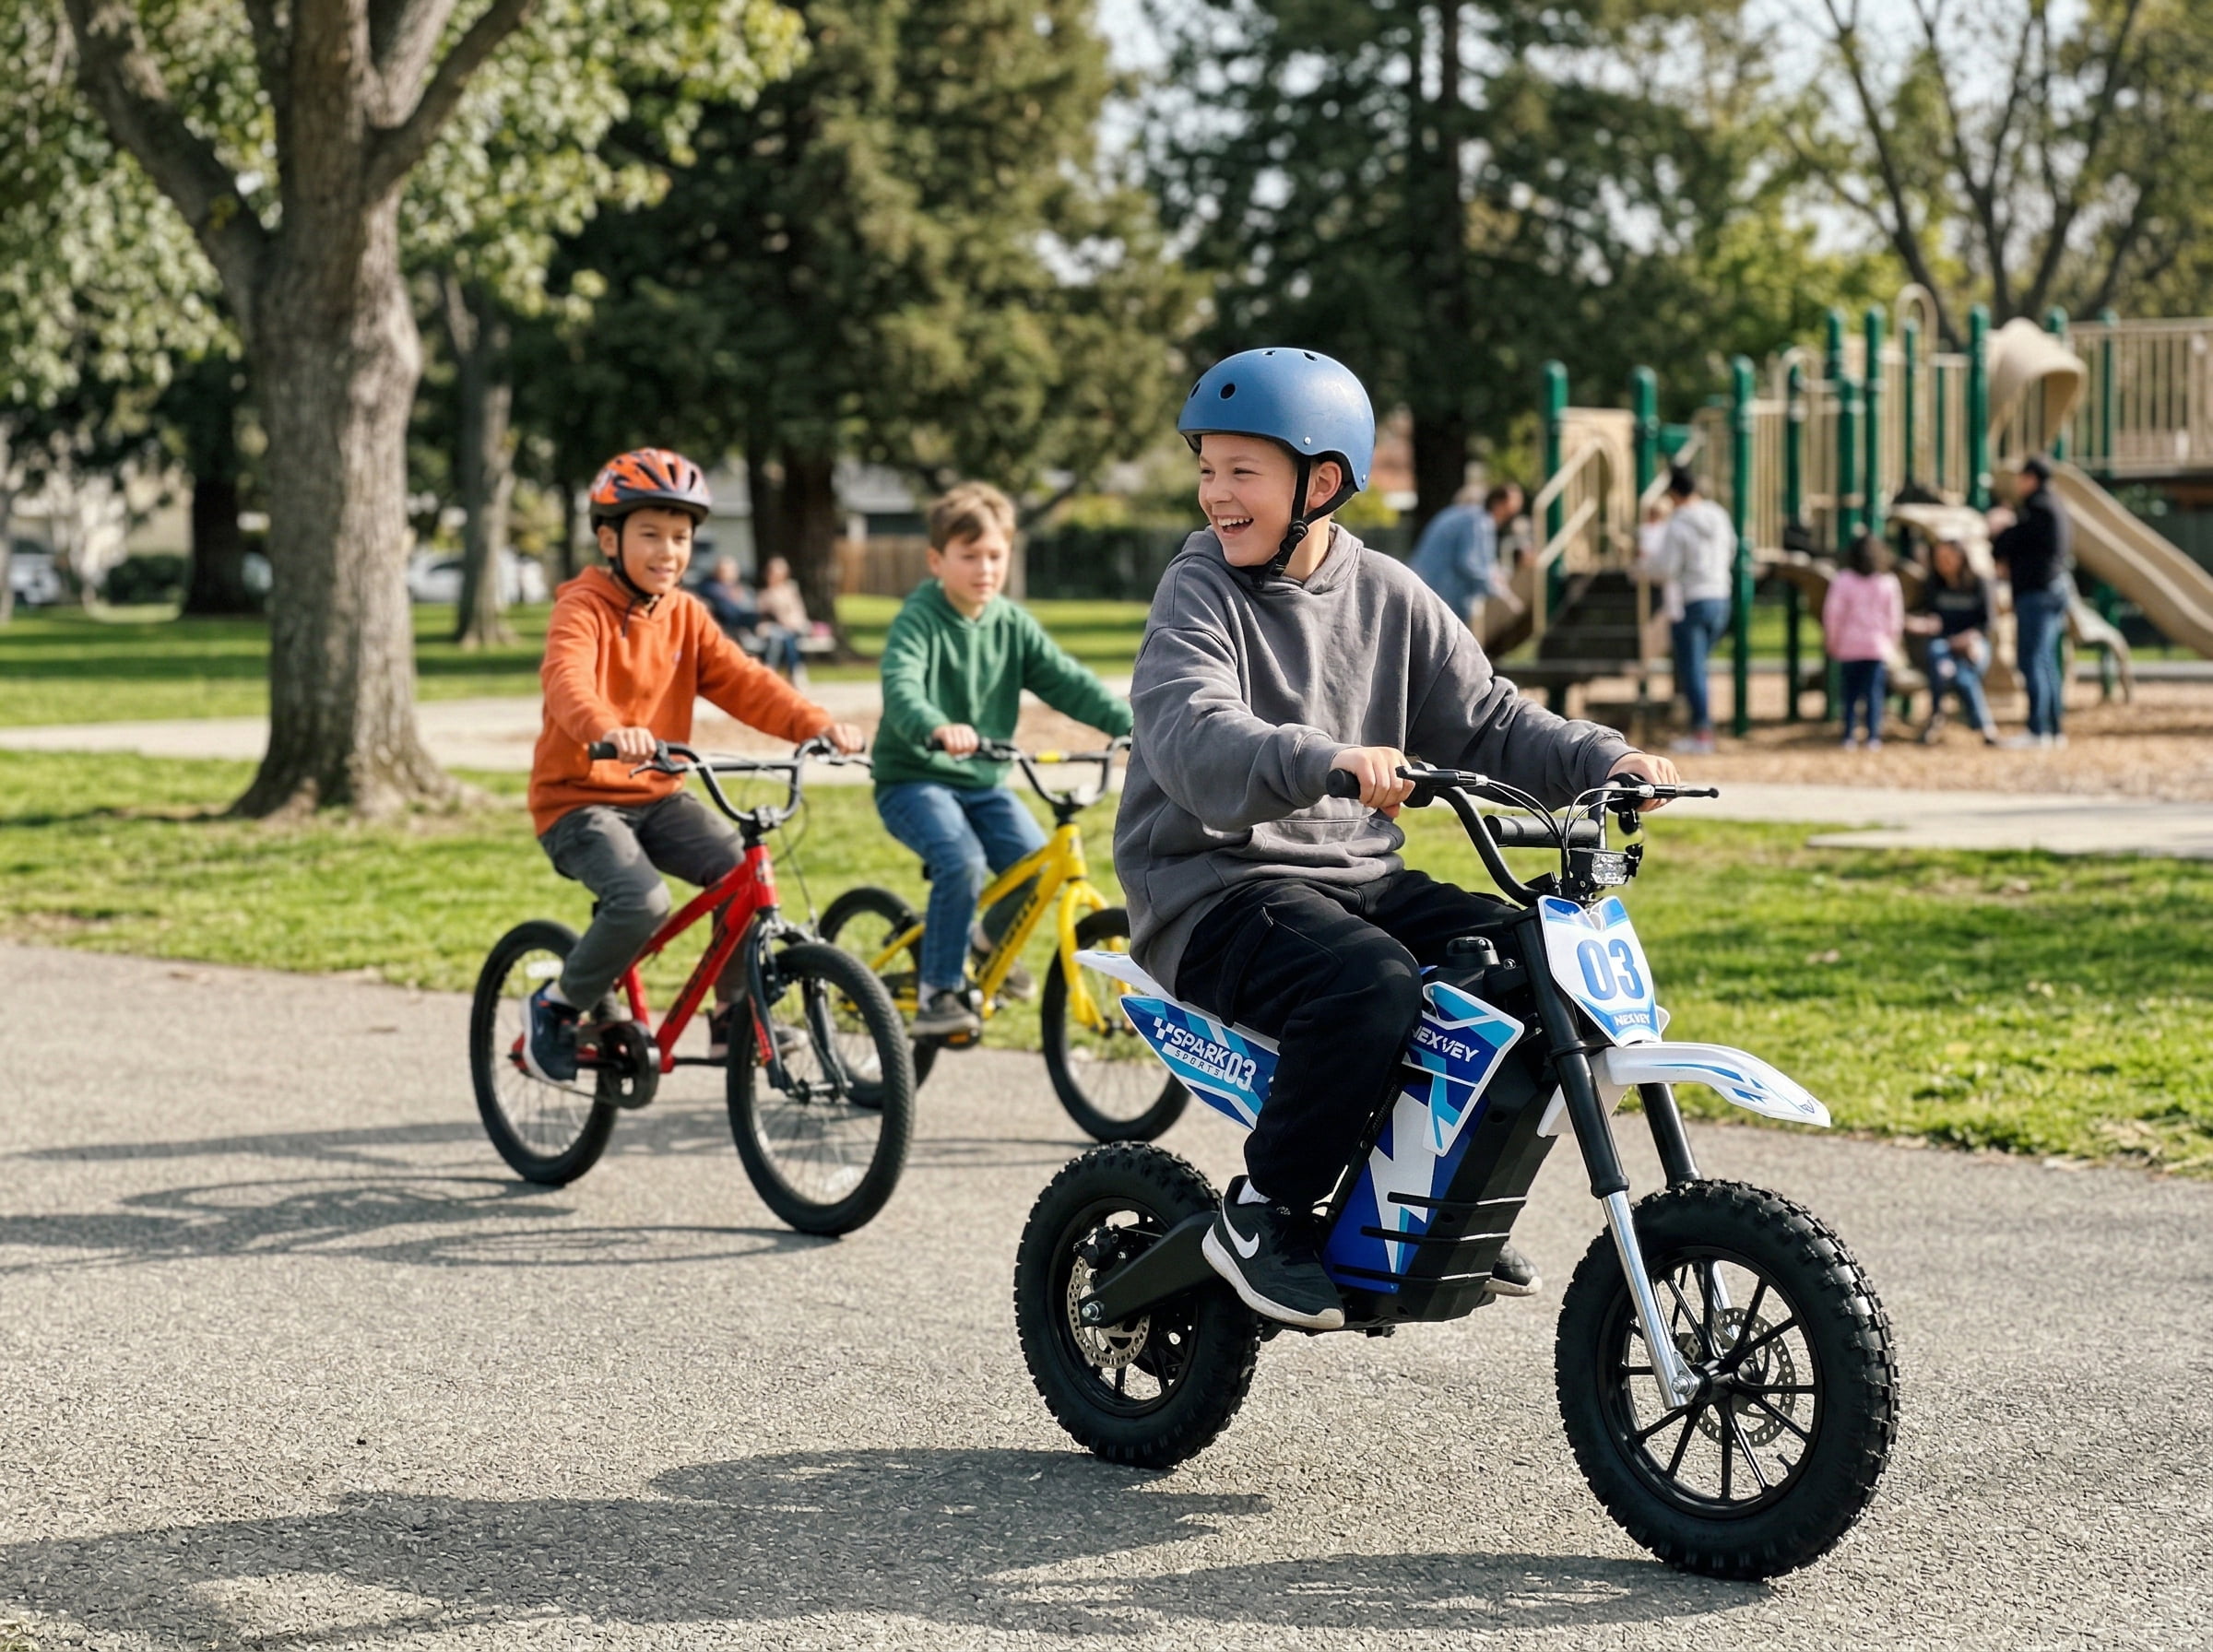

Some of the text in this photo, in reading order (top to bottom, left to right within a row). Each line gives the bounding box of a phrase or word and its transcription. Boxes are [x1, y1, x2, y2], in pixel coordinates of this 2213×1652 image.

[1577, 938, 1645, 1000] 03
[1613, 1012, 1651, 1026] NEXVEY
[1170, 1028, 1257, 1092] SPARK 03
[1174, 1049, 1221, 1076] SPORTS
